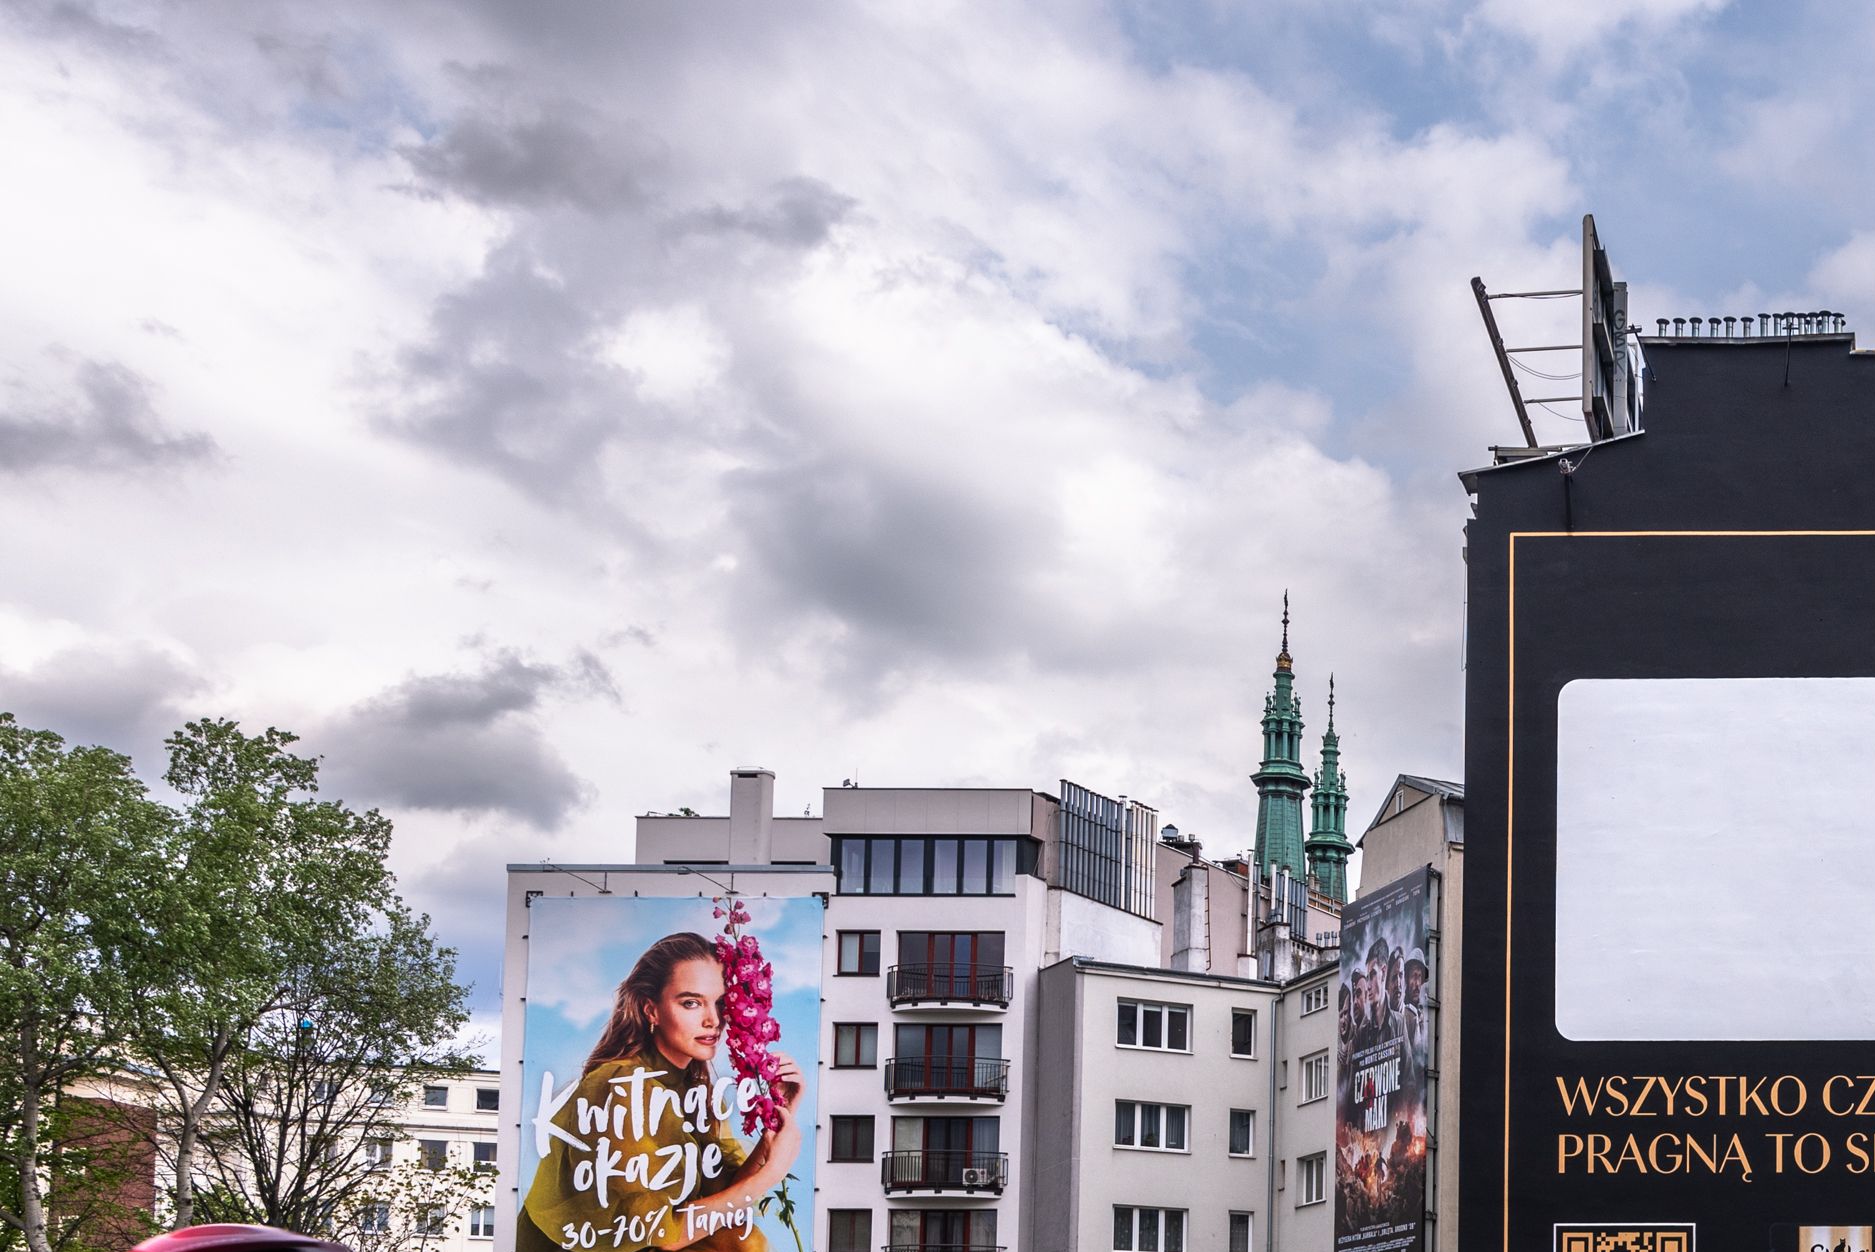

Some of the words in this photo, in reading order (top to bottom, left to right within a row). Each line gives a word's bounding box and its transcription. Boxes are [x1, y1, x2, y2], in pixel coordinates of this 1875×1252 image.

[532, 1067, 758, 1158] Kwitnące
[1555, 1075, 1807, 1117] WSZYSTKO
[573, 1136, 723, 1208] okazje
[1558, 1132, 1753, 1182] PRAGNĄ
[1765, 1132, 1831, 1174] TO
[561, 1205, 668, 1250] 30-70%
